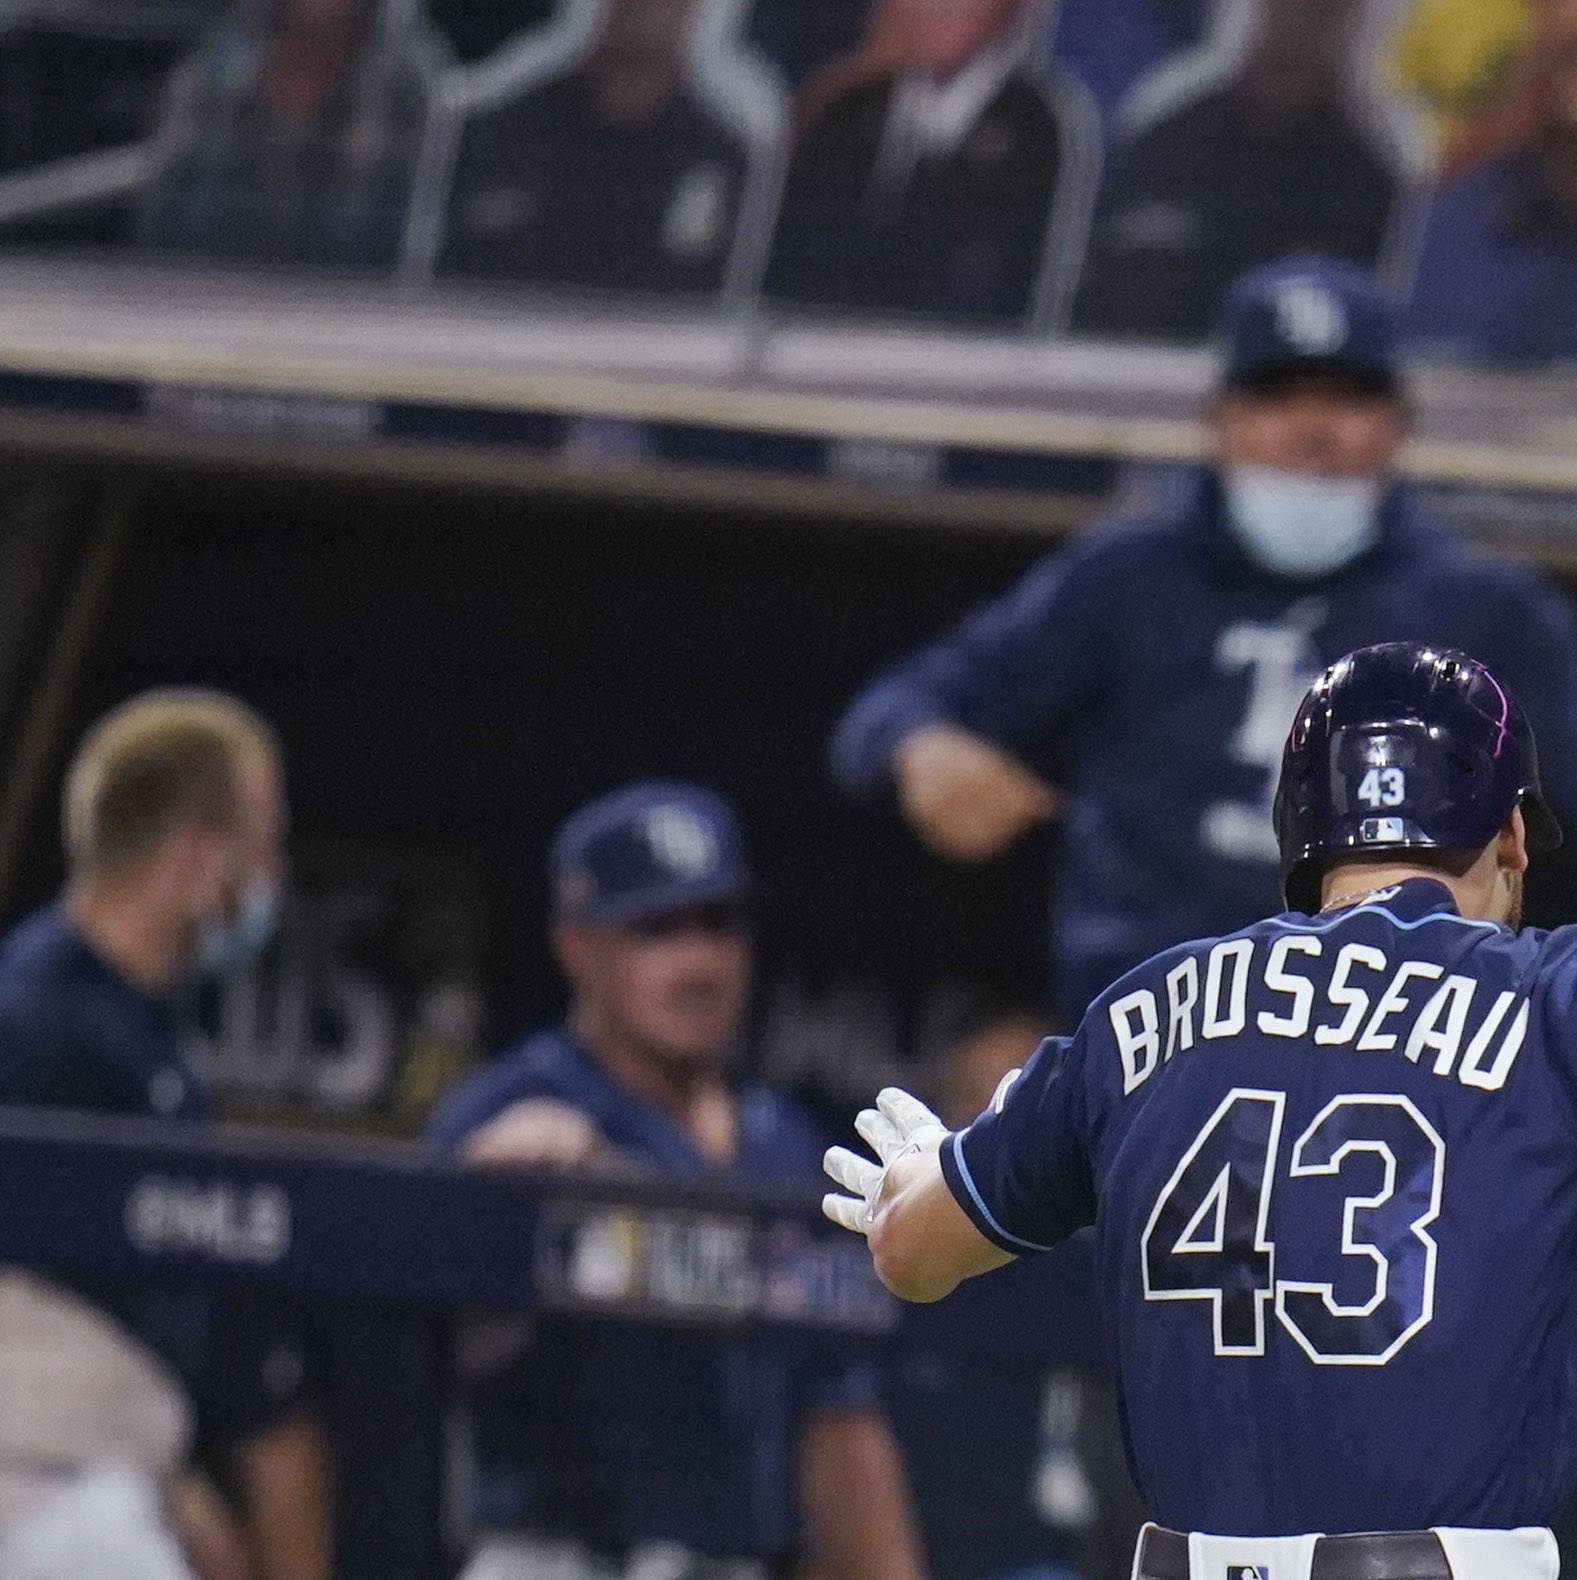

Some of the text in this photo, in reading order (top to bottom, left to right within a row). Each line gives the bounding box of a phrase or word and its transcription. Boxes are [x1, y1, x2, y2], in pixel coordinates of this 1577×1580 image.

[1357, 766, 1406, 808] 43
[1108, 934, 1531, 1097] BROSSEAU
[1140, 1087, 1447, 1366] 43
